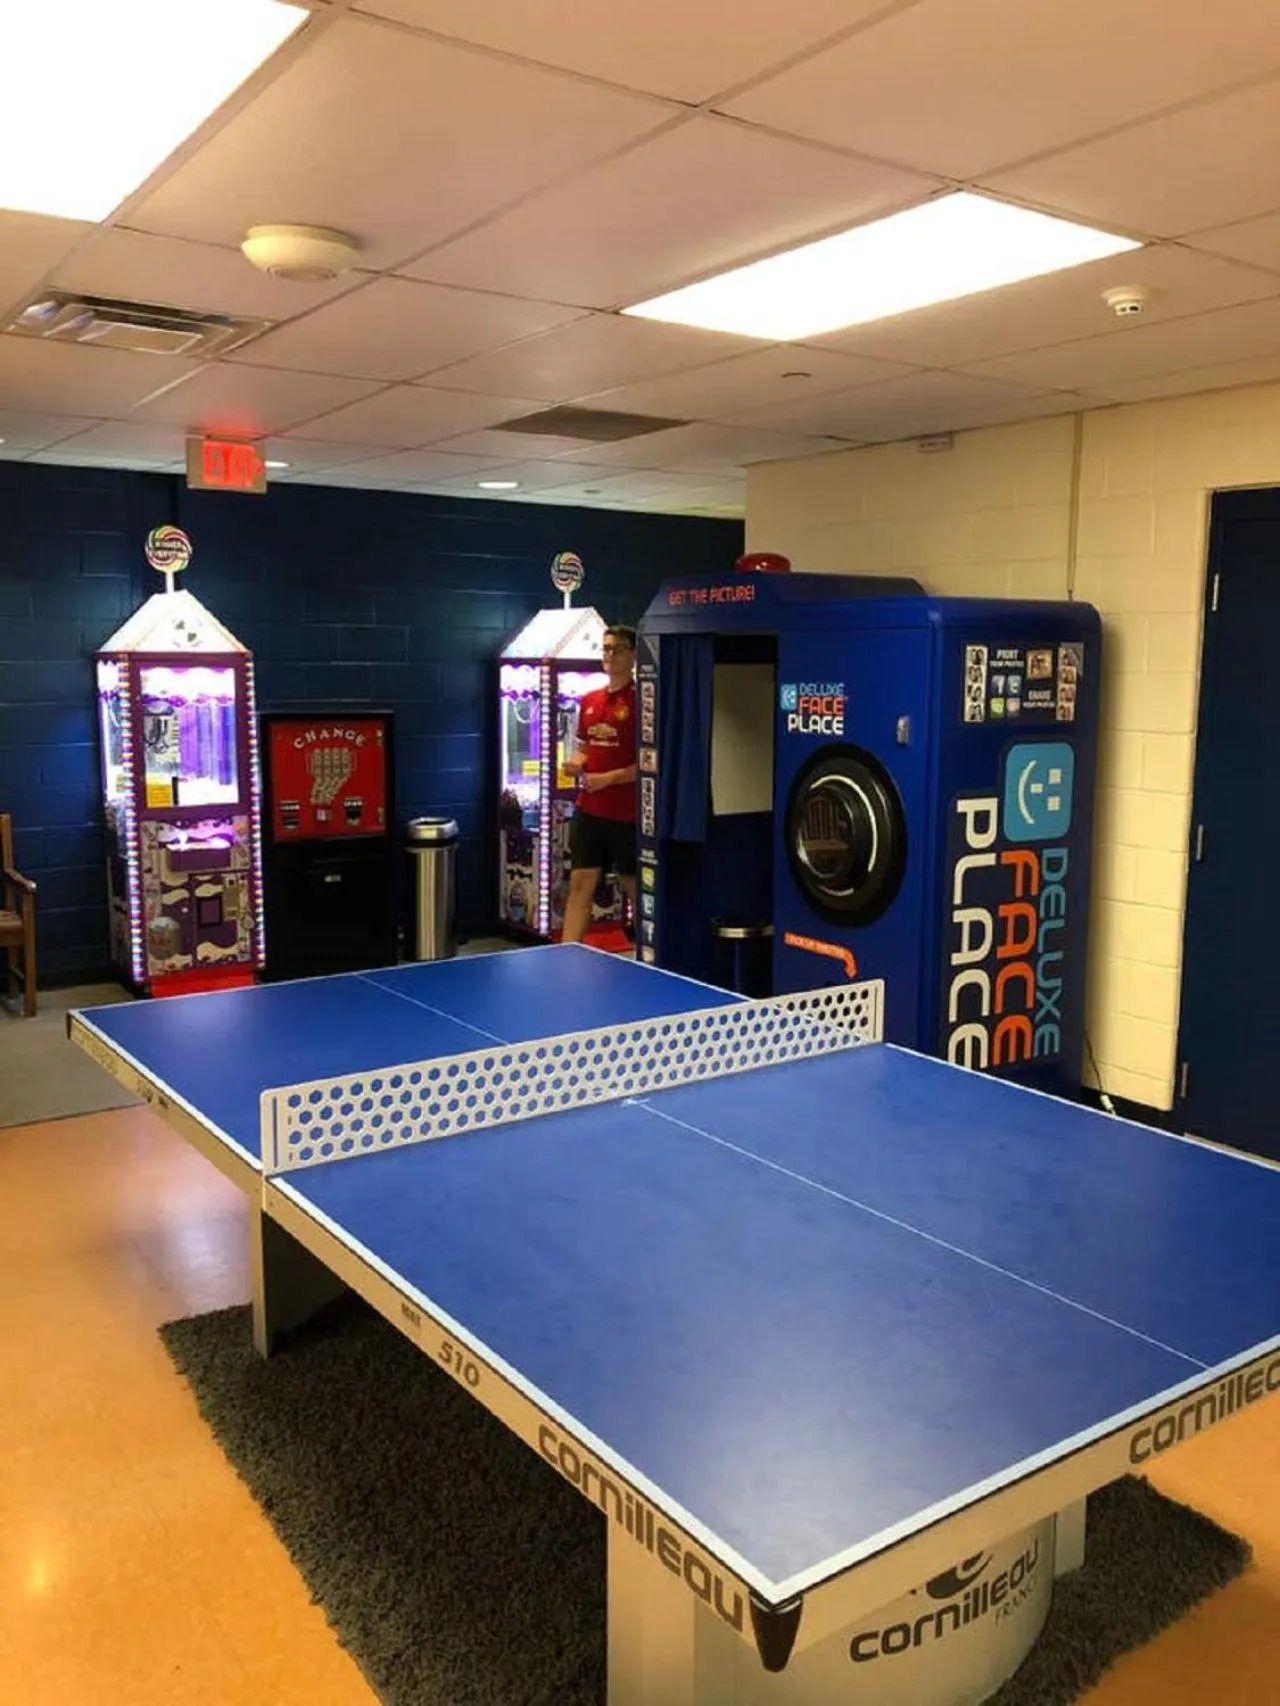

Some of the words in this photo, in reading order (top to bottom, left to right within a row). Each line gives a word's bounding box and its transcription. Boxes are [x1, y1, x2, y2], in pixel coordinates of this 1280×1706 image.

[203, 441, 255, 487] EXIT
[799, 683, 844, 696] DELUXE
[799, 696, 844, 715] FACE
[294, 728, 366, 749] CHANGE
[787, 713, 844, 735] PLACE
[949, 797, 998, 1070] PLACE
[1033, 847, 1069, 1057] DELUXE
[992, 850, 1040, 1067] FACE
[438, 1341, 480, 1388] 510
[538, 1423, 744, 1632] cornilleau
[850, 1537, 1039, 1663] cornilleau
